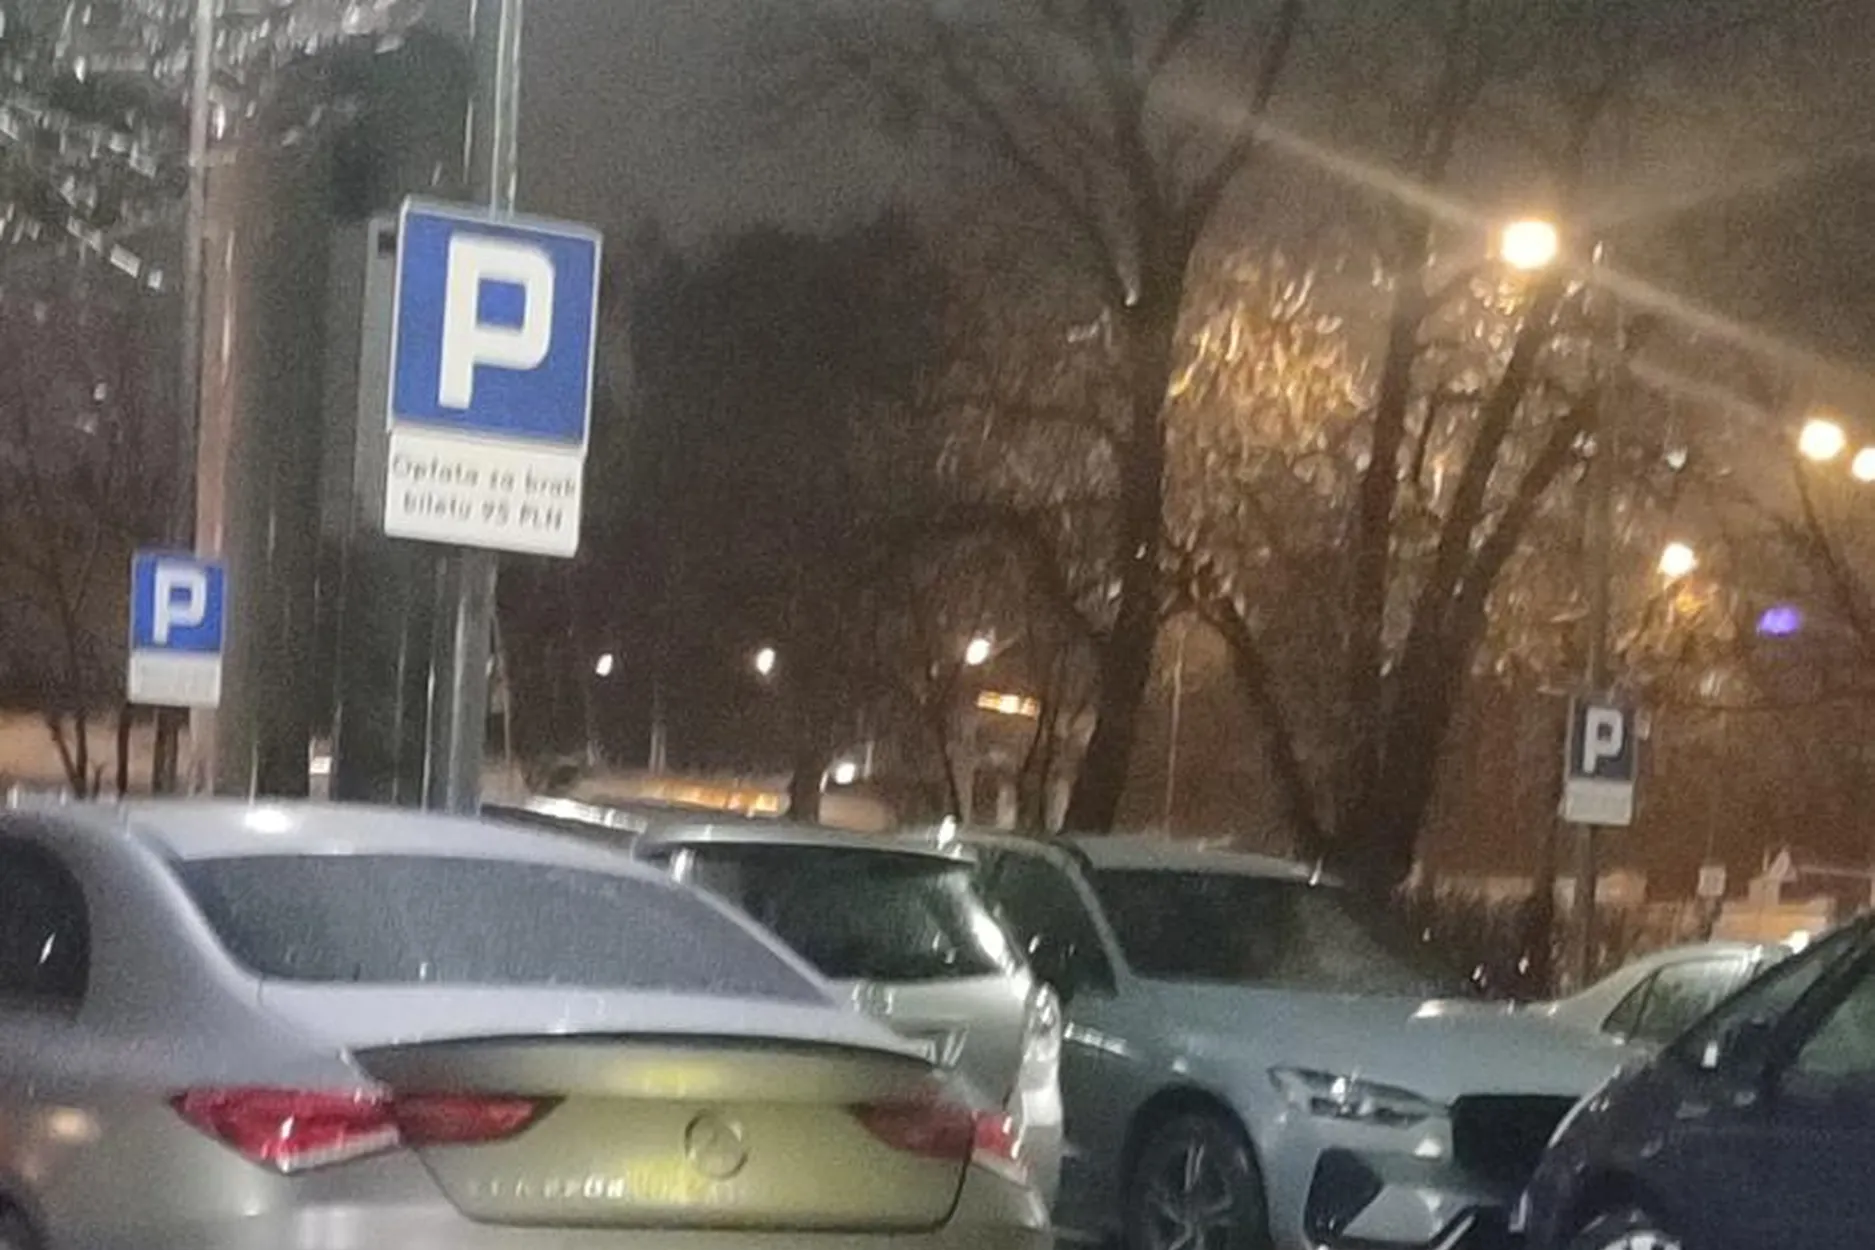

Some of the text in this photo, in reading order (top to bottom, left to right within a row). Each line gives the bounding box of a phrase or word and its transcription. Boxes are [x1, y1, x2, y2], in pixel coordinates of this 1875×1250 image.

[439, 233, 556, 409] P
[154, 561, 207, 644] P
[1583, 707, 1624, 774] P
